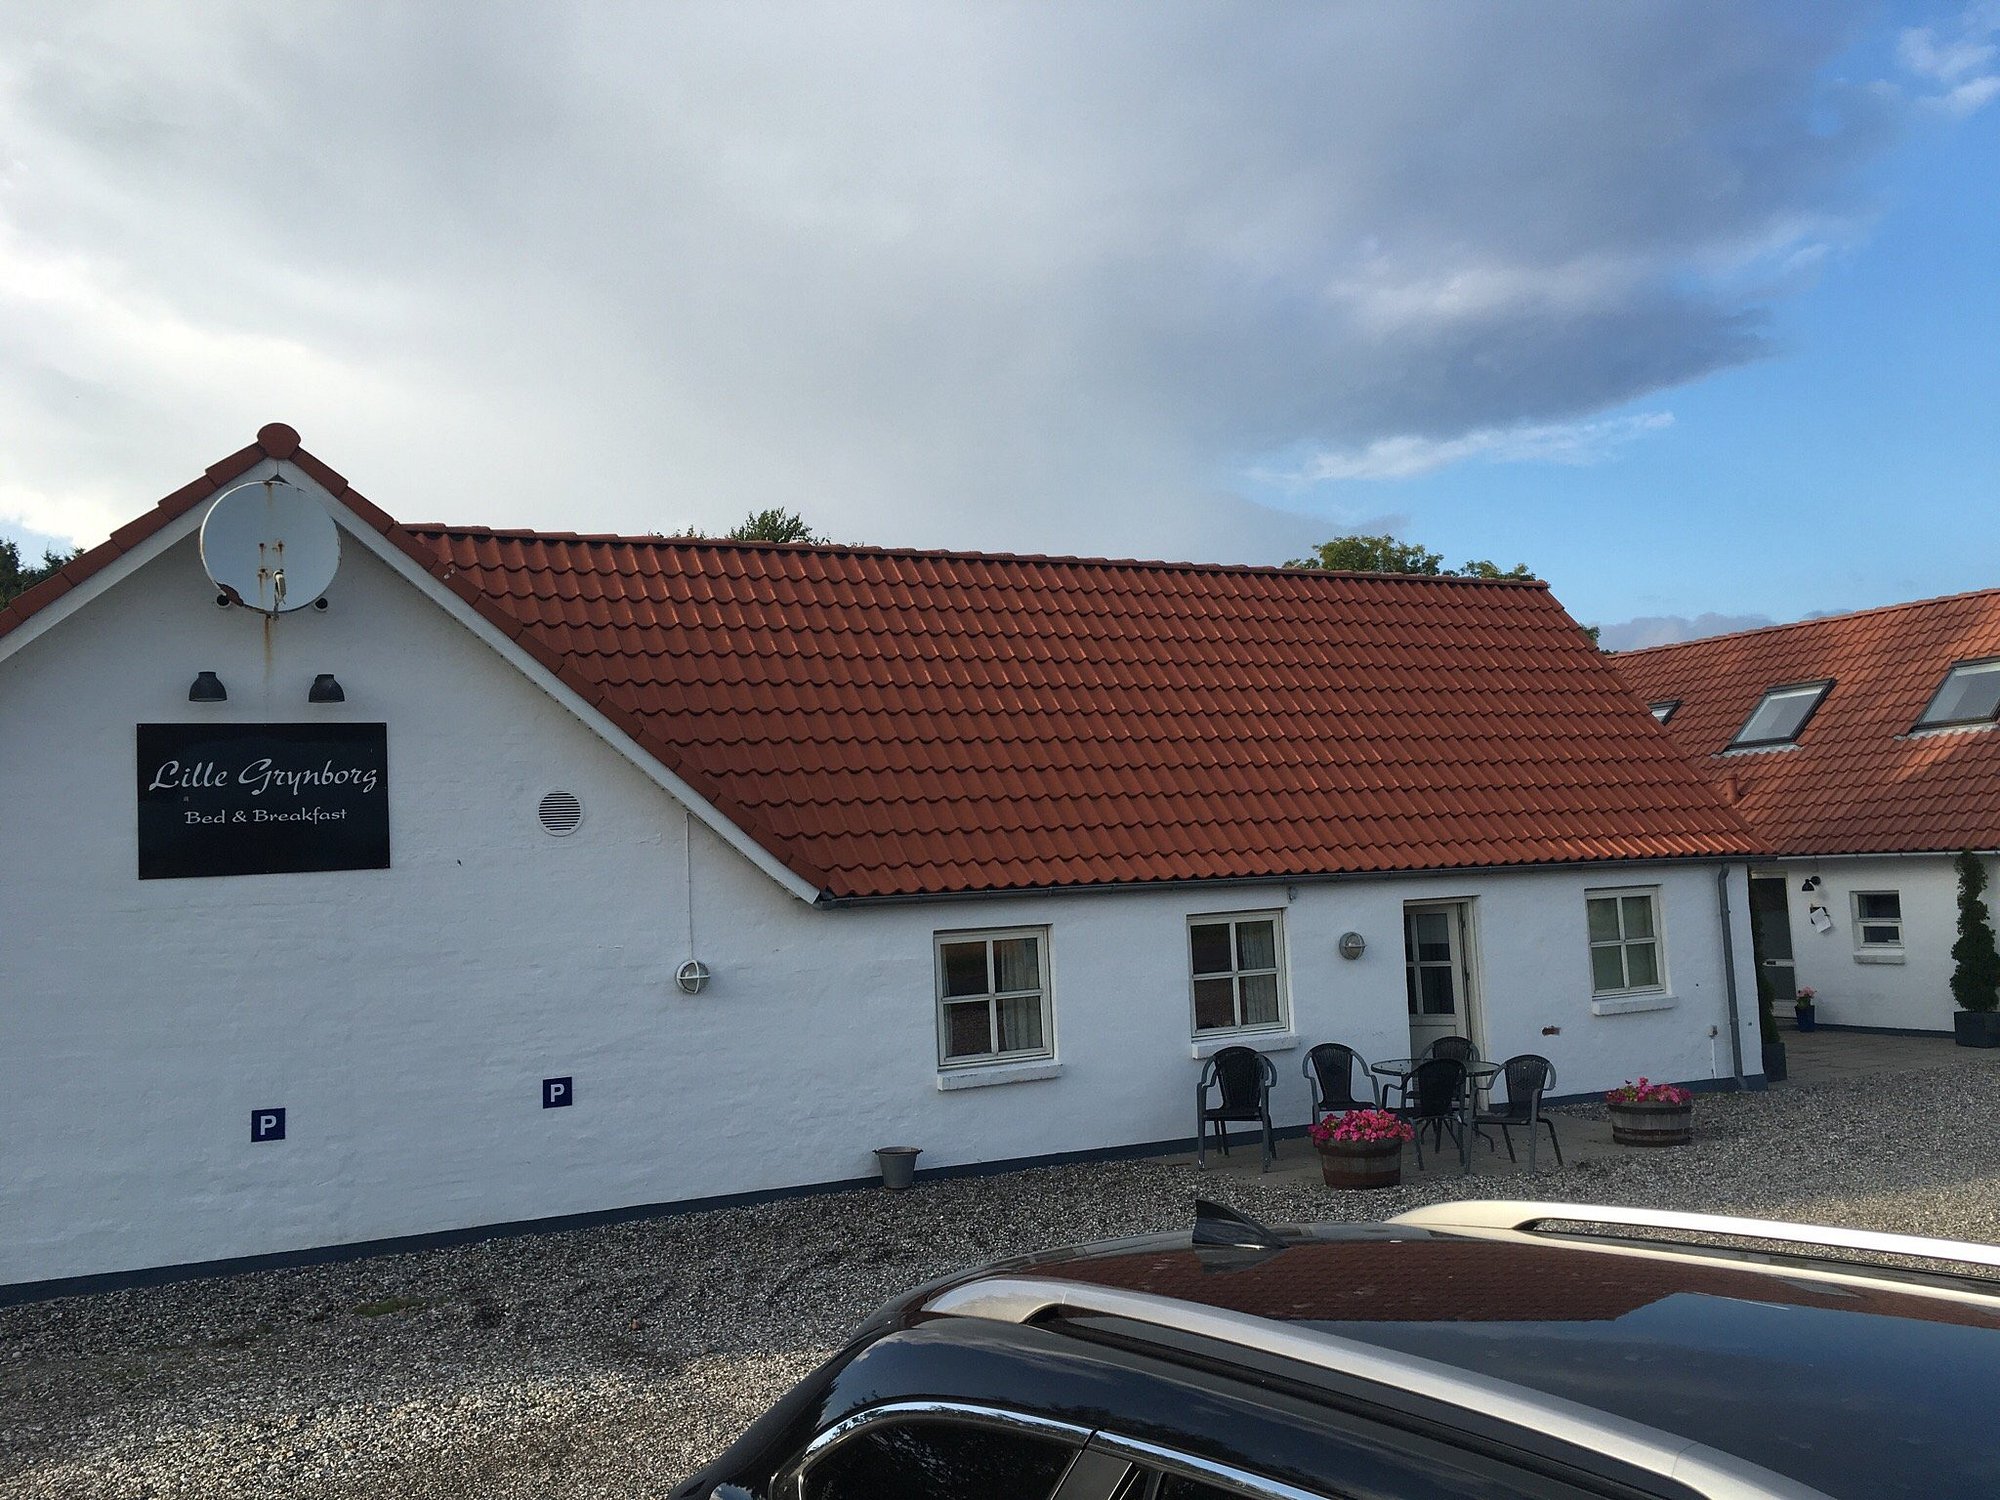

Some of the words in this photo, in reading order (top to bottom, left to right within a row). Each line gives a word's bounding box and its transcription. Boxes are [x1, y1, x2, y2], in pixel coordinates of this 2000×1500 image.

[149, 760, 228, 791] Lille
[238, 758, 378, 796] Grynborg
[184, 810, 225, 824] Bed
[232, 810, 247, 823] &
[253, 806, 347, 825] Breakfast
[550, 1083, 565, 1103] P
[260, 1115, 277, 1136] P
